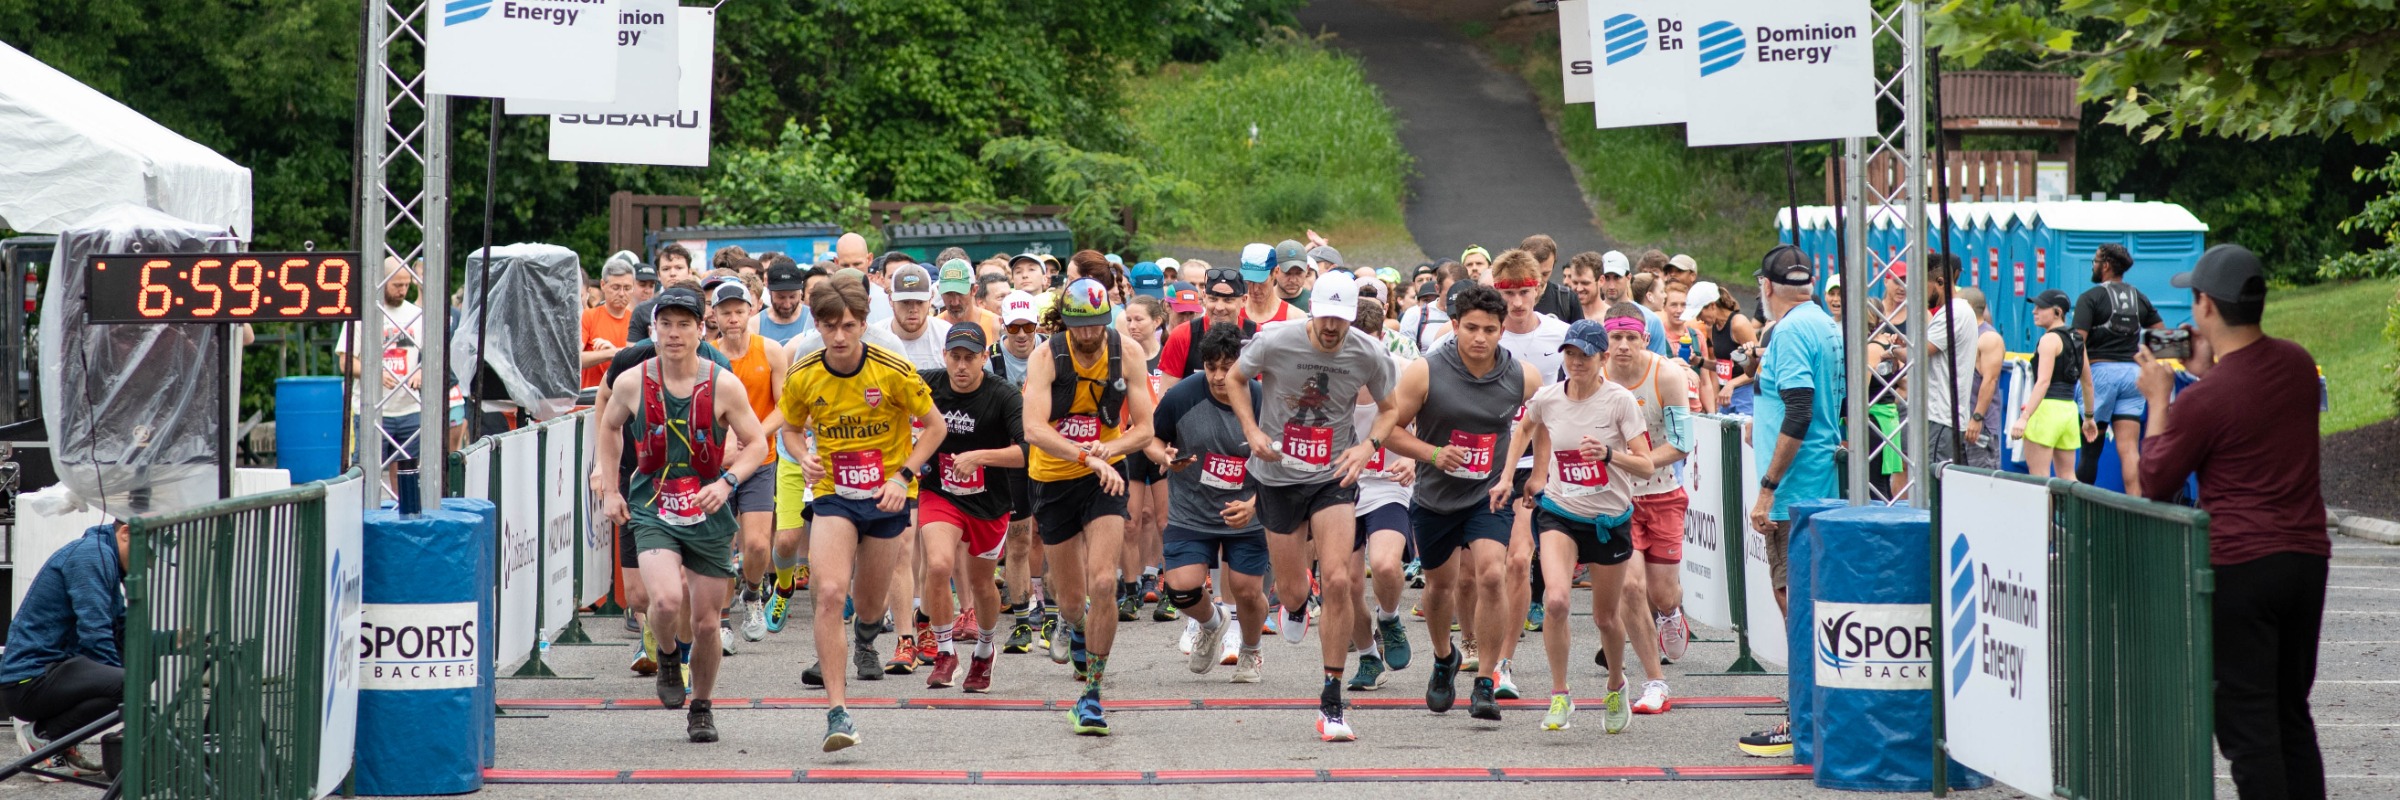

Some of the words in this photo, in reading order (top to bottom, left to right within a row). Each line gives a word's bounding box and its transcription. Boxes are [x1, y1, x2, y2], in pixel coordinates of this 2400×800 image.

[503, 2, 579, 26] Energy
[618, 10, 664, 25] inion
[1756, 23, 1857, 44] Dominion
[1758, 44, 1832, 64] Energy
[1010, 300, 1030, 310] RUN
[1296, 363, 1351, 375] superpacker
[818, 420, 890, 440] Emirates
[1060, 423, 1097, 438] 2065
[1288, 442, 1328, 458] 1816
[1463, 452, 1489, 465] 915
[839, 467, 880, 485] 1968
[1209, 461, 1243, 476] 1835
[1563, 464, 1600, 482] 1901
[1981, 562, 2038, 629] Dominion
[359, 620, 474, 660] SPORTS
[1844, 621, 1932, 658] SPOR
[1981, 622, 2024, 700] Energy
[374, 663, 474, 678] BACKERS
[1865, 665, 1927, 678] BACK
